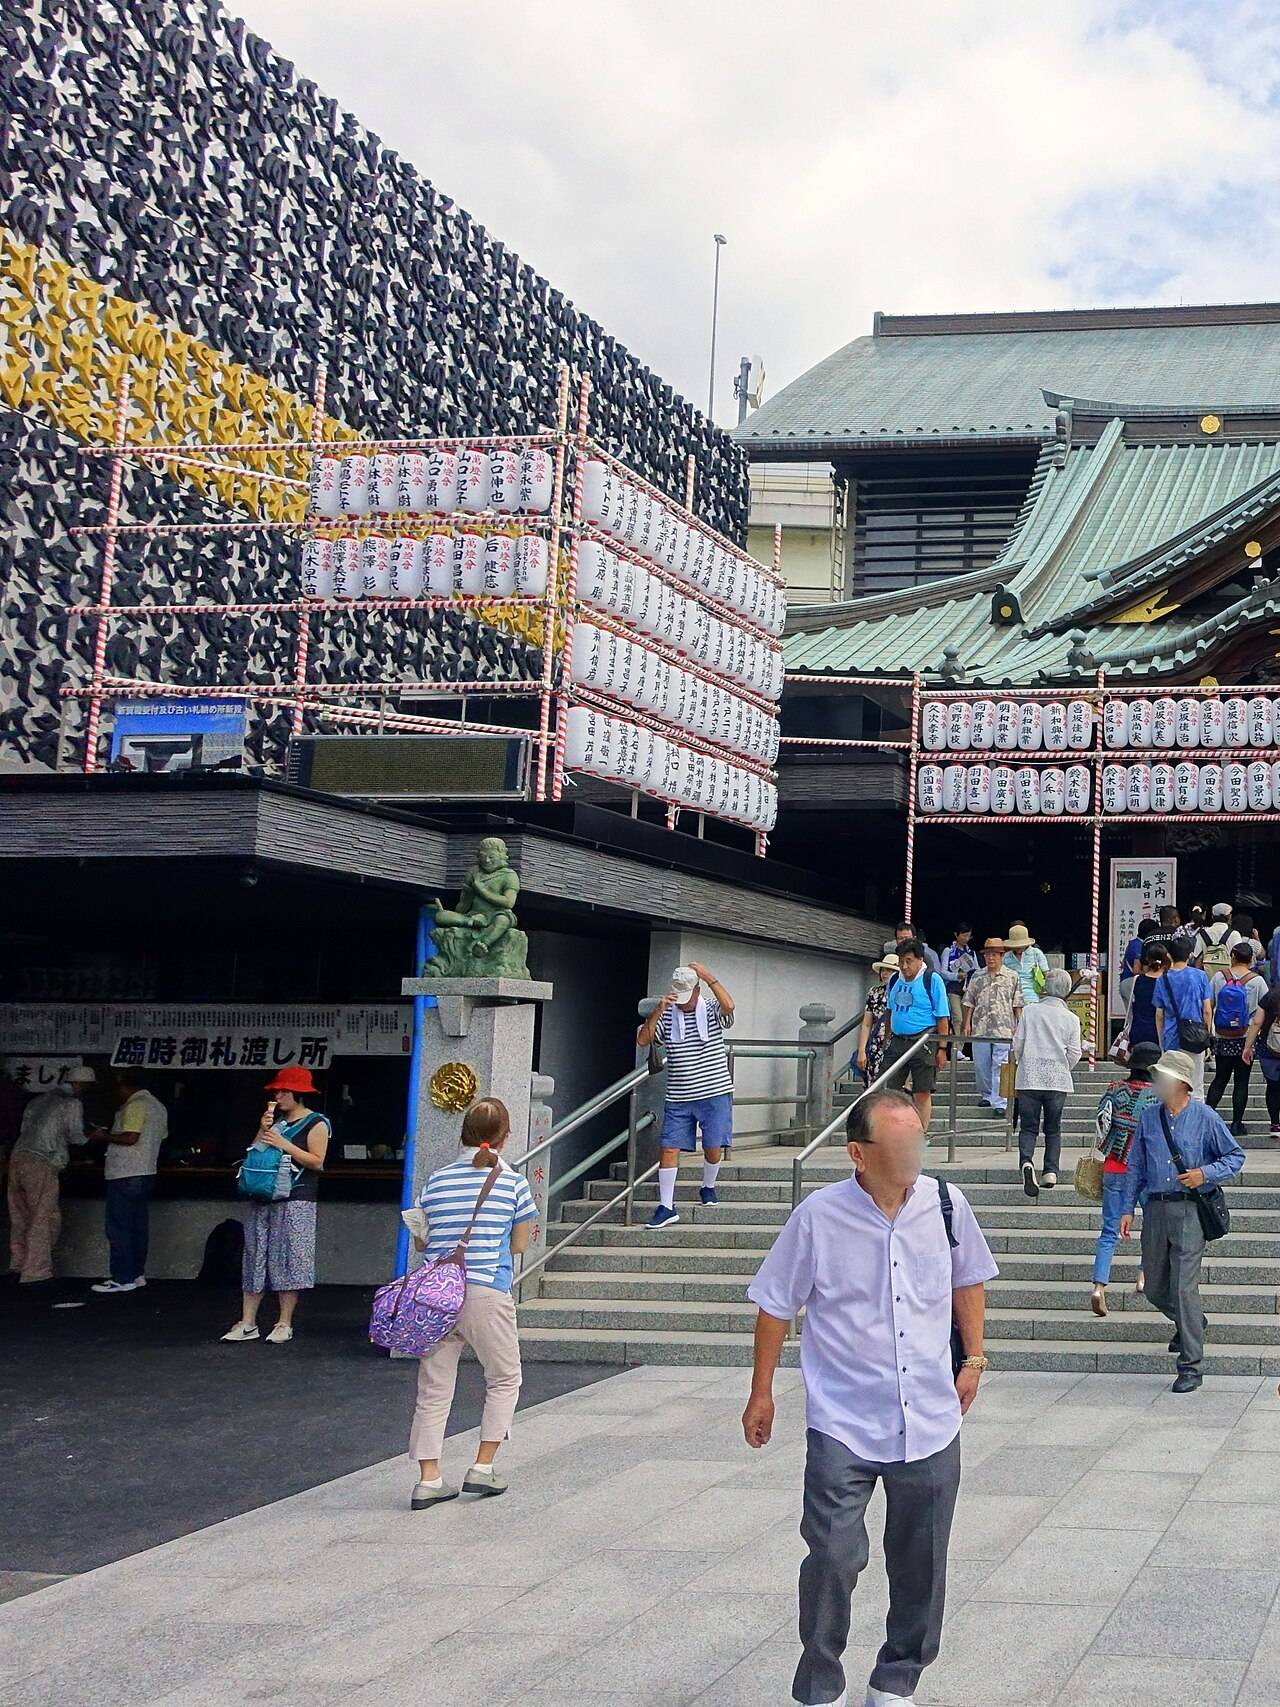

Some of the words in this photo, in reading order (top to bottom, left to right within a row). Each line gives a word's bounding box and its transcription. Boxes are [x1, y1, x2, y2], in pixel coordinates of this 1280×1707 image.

[304, 541, 320, 595] 荒木早苗
[115, 1036, 328, 1066] 臨時御札渡し所
